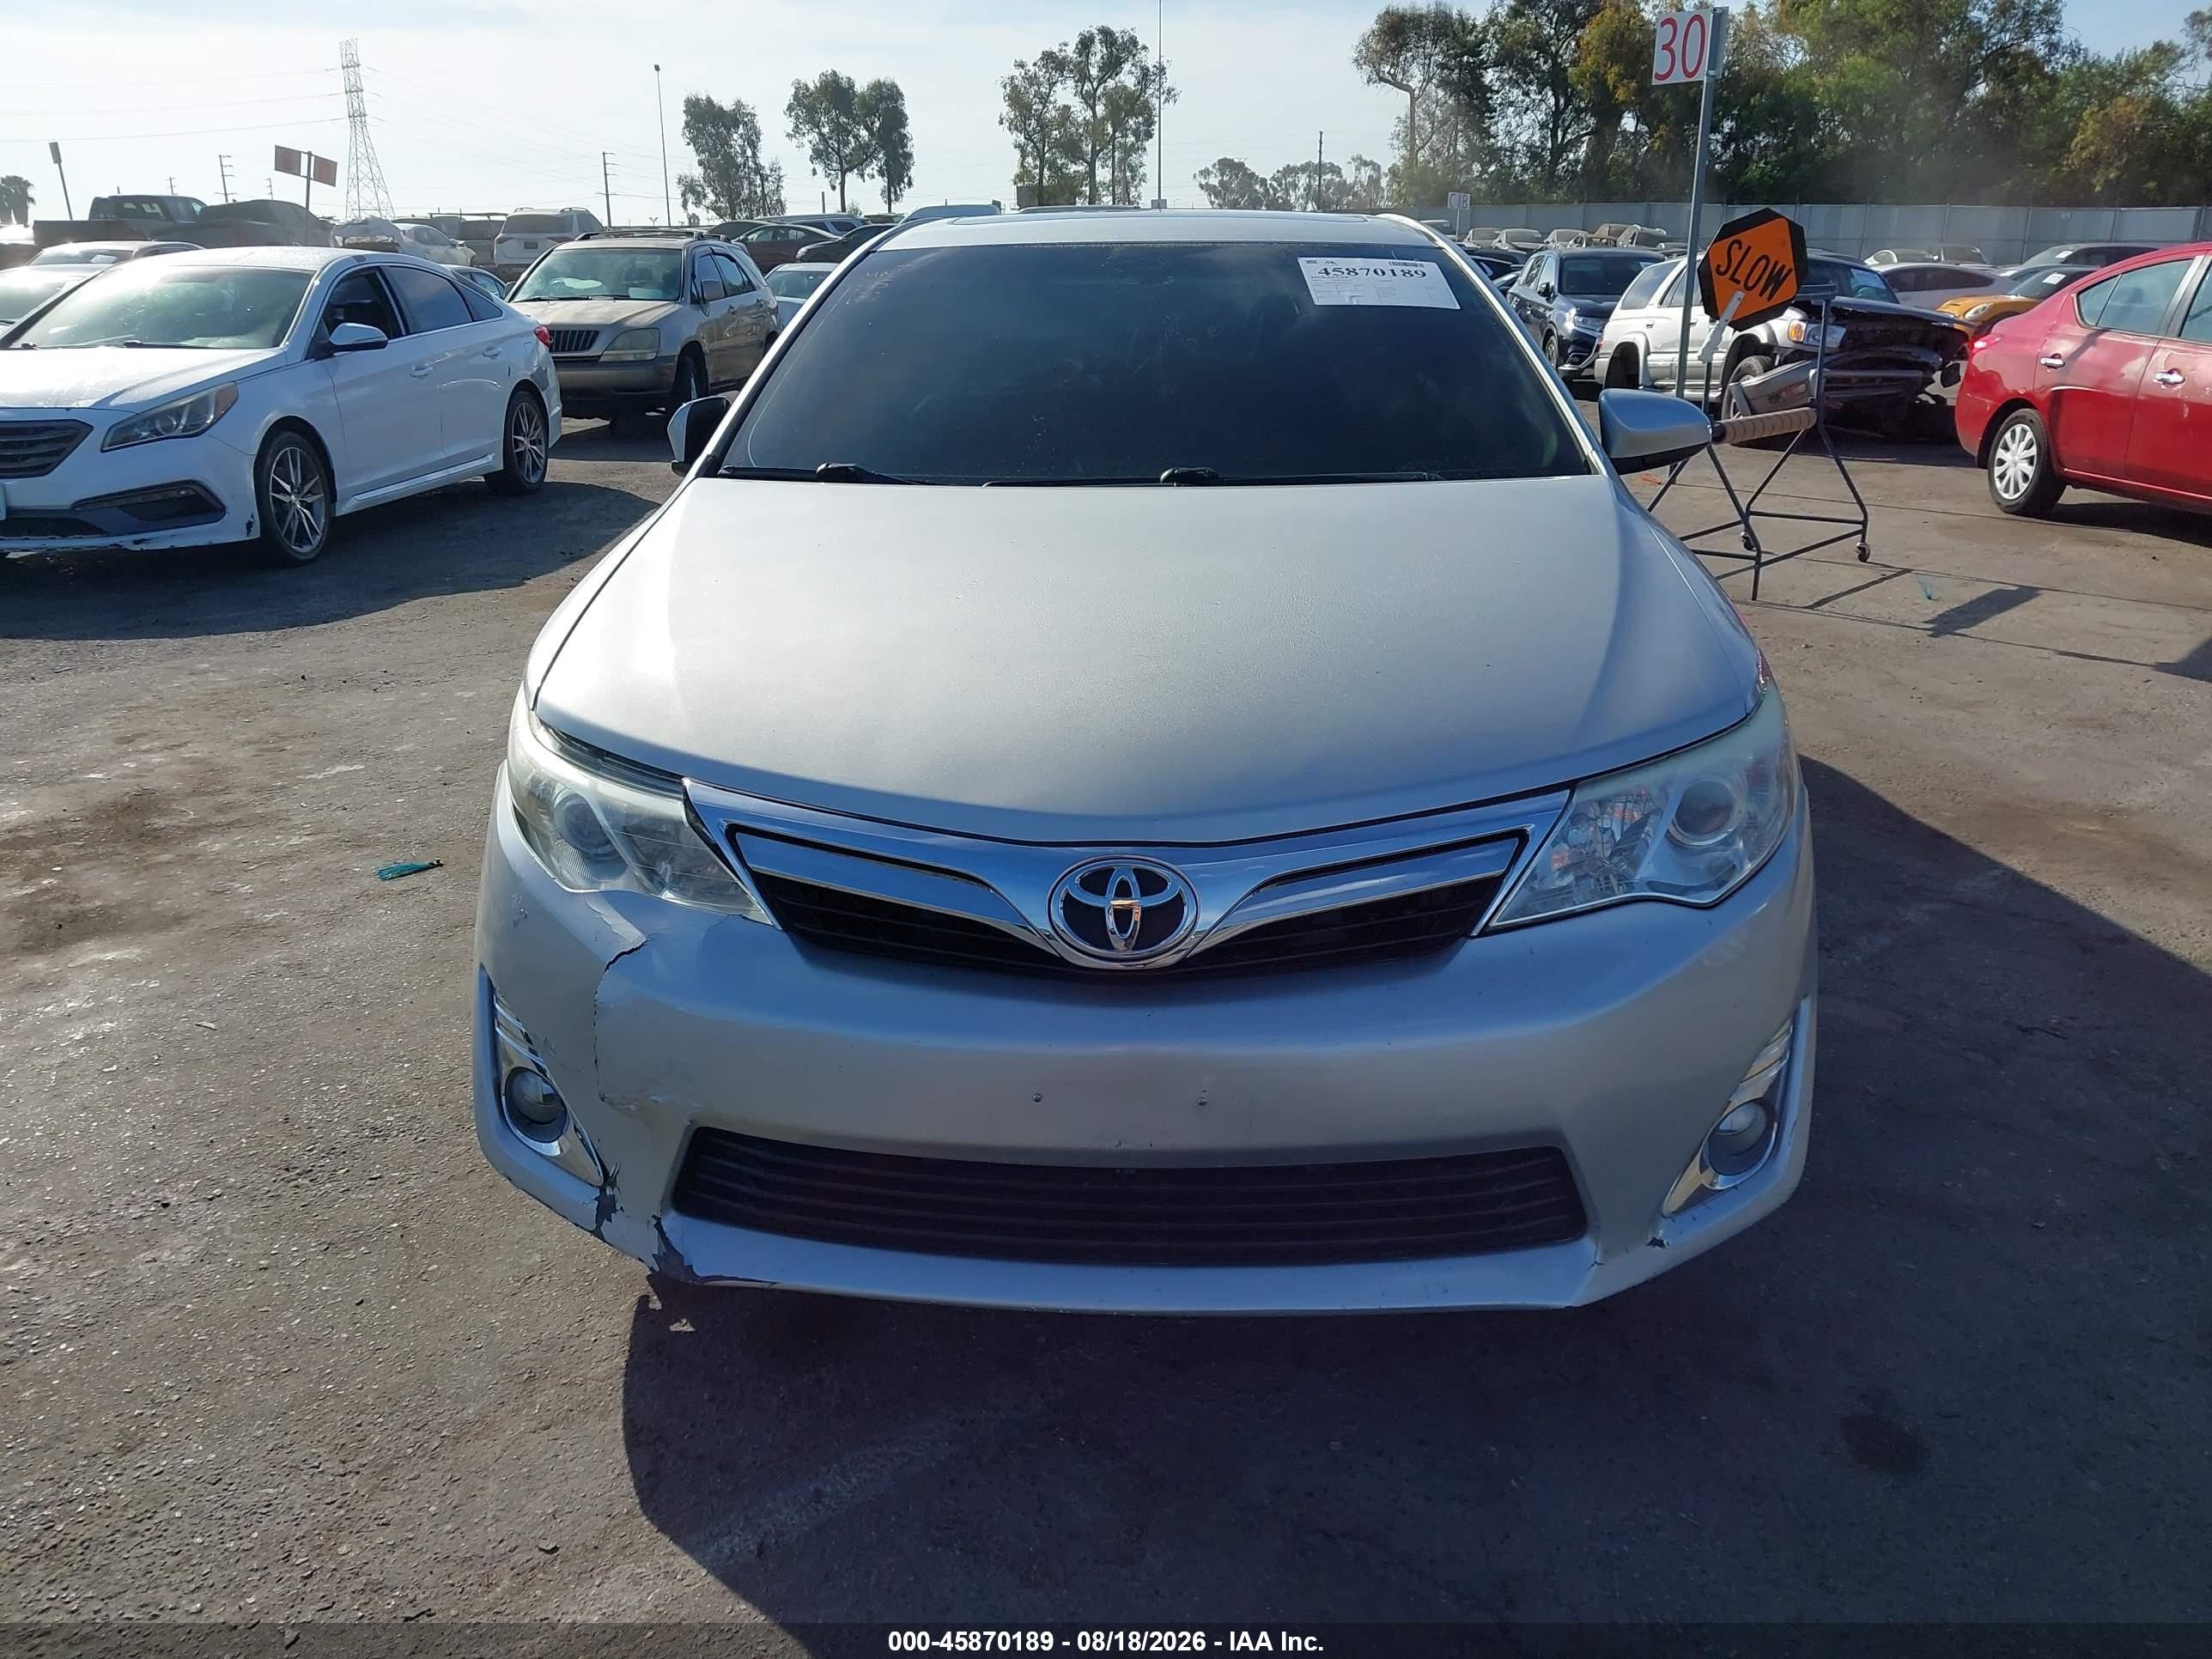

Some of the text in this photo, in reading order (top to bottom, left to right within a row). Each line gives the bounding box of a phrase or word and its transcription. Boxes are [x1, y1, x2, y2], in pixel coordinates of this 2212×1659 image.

[1654, 14, 1706, 82] 30
[1317, 266, 1427, 279] 45870189
[1716, 239, 1794, 302] SLOW
